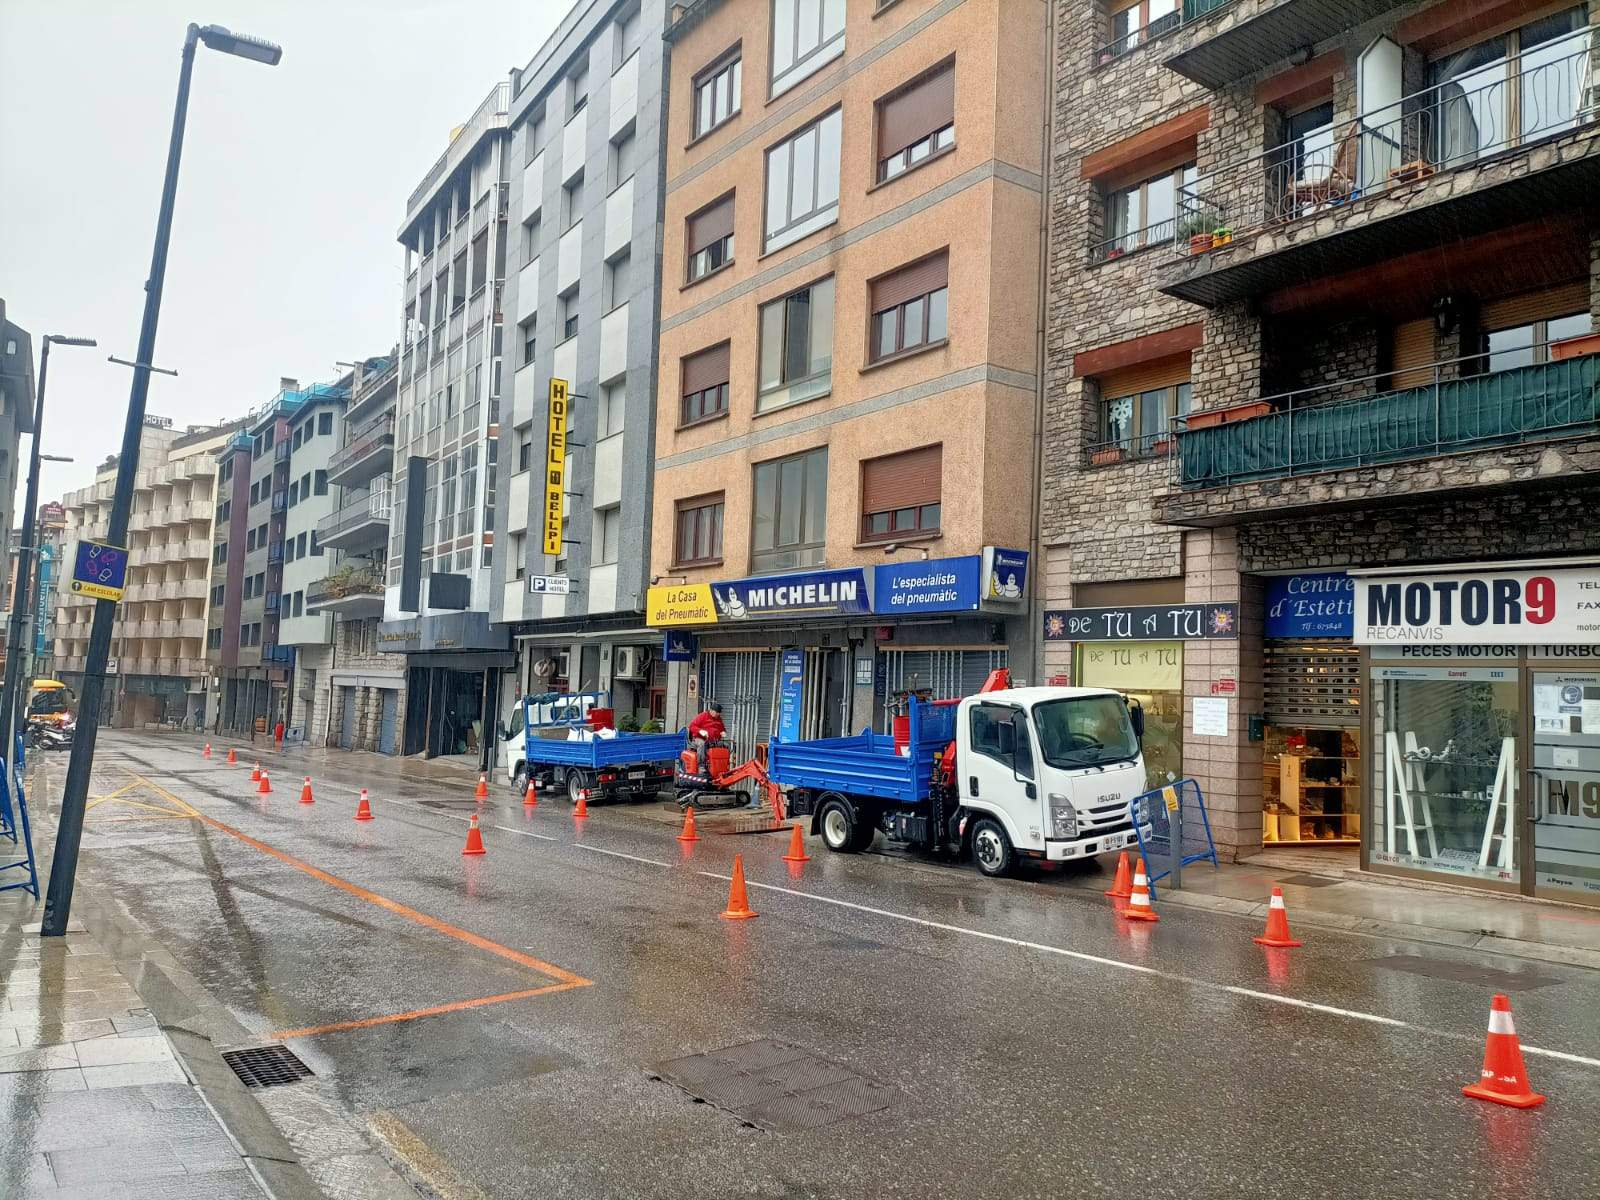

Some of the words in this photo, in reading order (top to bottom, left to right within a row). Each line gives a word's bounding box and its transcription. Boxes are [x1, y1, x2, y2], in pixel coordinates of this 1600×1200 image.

[551, 385, 564, 464] HOTEL
[549, 492, 559, 550] BELLPI
[893, 573, 956, 590] L'especialista
[1288, 577, 1355, 594] Centre
[667, 592, 676, 604] La
[678, 590, 697, 602] Casa
[748, 581, 857, 608] MICHELIN
[891, 592, 905, 605] del
[907, 590, 958, 606] pneumàtic
[1368, 576, 1556, 627] MOTOR9
[656, 609, 667, 620] del
[669, 606, 708, 620] Pneumàtic
[1577, 602, 1600, 610] FAX
[1069, 616, 1092, 633] DE
[1101, 611, 1132, 637] TU
[1143, 613, 1157, 635] A
[1167, 609, 1203, 636] TU
[1366, 627, 1443, 640] RECANVIS
[1090, 650, 1104, 662] DE
[1111, 648, 1131, 665] TU
[1139, 651, 1148, 664] A
[1155, 648, 1177, 666] TU
[1402, 645, 1452, 657] PECES
[1457, 645, 1516, 657] MOTOR
[1097, 792, 1121, 802] ISUZU
